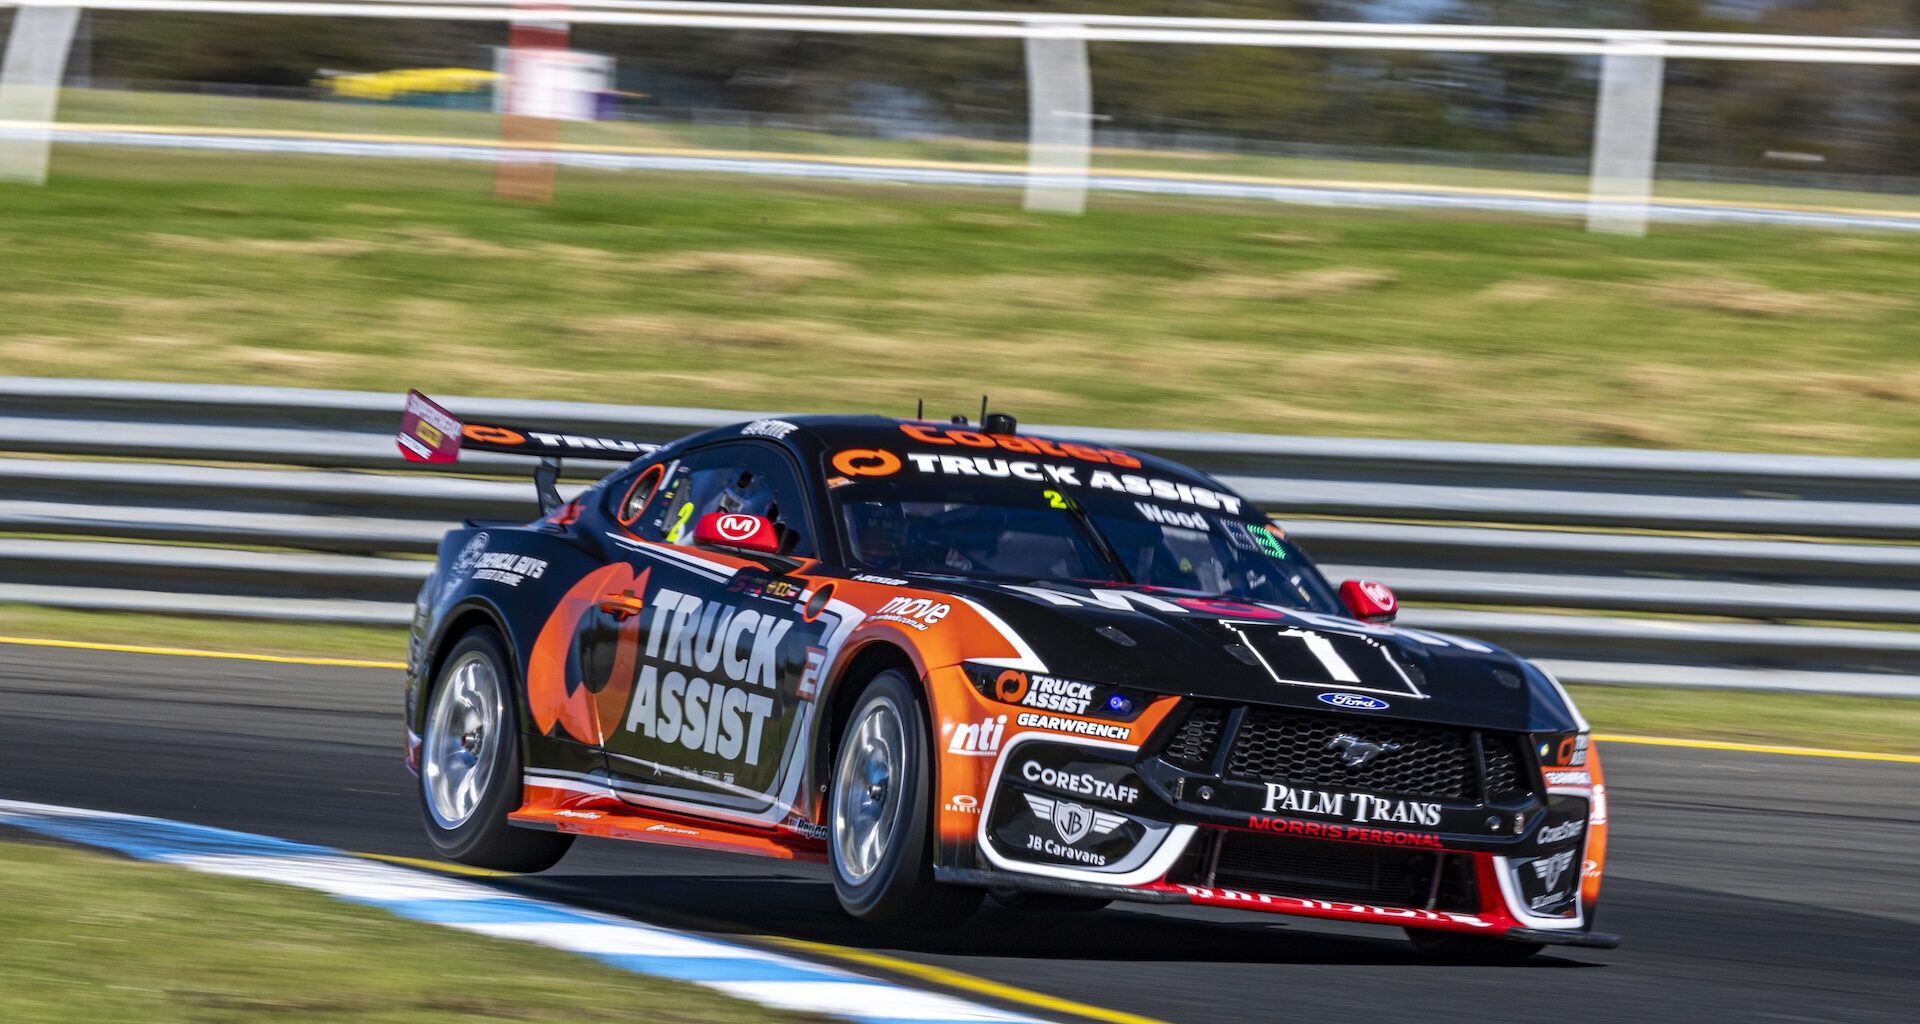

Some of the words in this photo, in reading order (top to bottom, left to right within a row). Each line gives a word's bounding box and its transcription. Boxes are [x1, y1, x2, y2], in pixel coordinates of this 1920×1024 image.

[908, 453, 1081, 487] TRUCK
[1090, 470, 1241, 516] ASSIST
[1043, 490, 1068, 510] 2
[1134, 501, 1211, 532] Wood
[876, 596, 951, 624] move
[645, 588, 794, 690] TRUCK
[1022, 691, 1090, 714] ASSIST
[1031, 675, 1096, 700] TRUCK
[1332, 694, 1377, 708] Ford
[626, 664, 774, 766] ASSIST
[1016, 713, 1130, 740] GEARWRENCH
[948, 714, 1008, 754] nti
[1262, 782, 1345, 816] PALM
[1350, 792, 1442, 826] TRANS
[1249, 816, 1343, 838] MORRIS
[1347, 826, 1443, 847] PERSONAL
[1026, 834, 1043, 851] JB
[1044, 837, 1107, 867] Caravans
